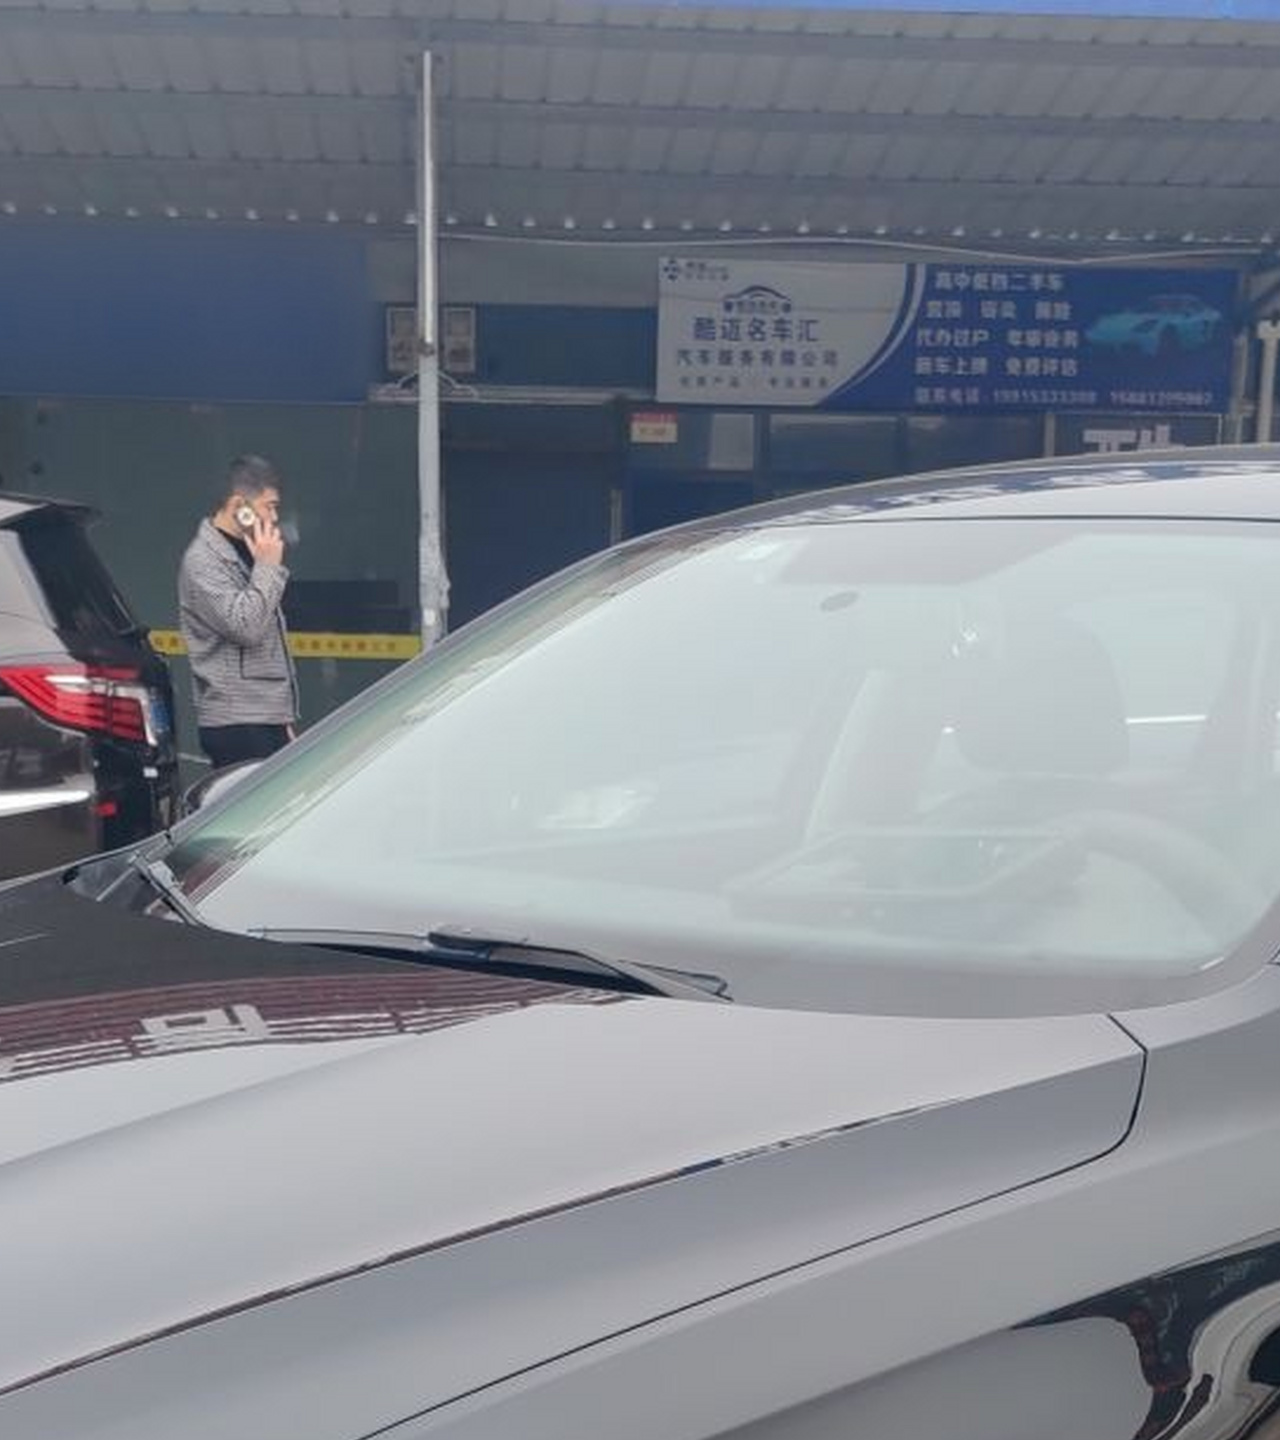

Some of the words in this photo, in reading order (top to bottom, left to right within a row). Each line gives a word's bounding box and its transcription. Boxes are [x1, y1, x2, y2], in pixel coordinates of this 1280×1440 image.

[693, 317, 819, 342] 酷迈名车汇
[677, 350, 838, 367] 汽车服务有限公司
